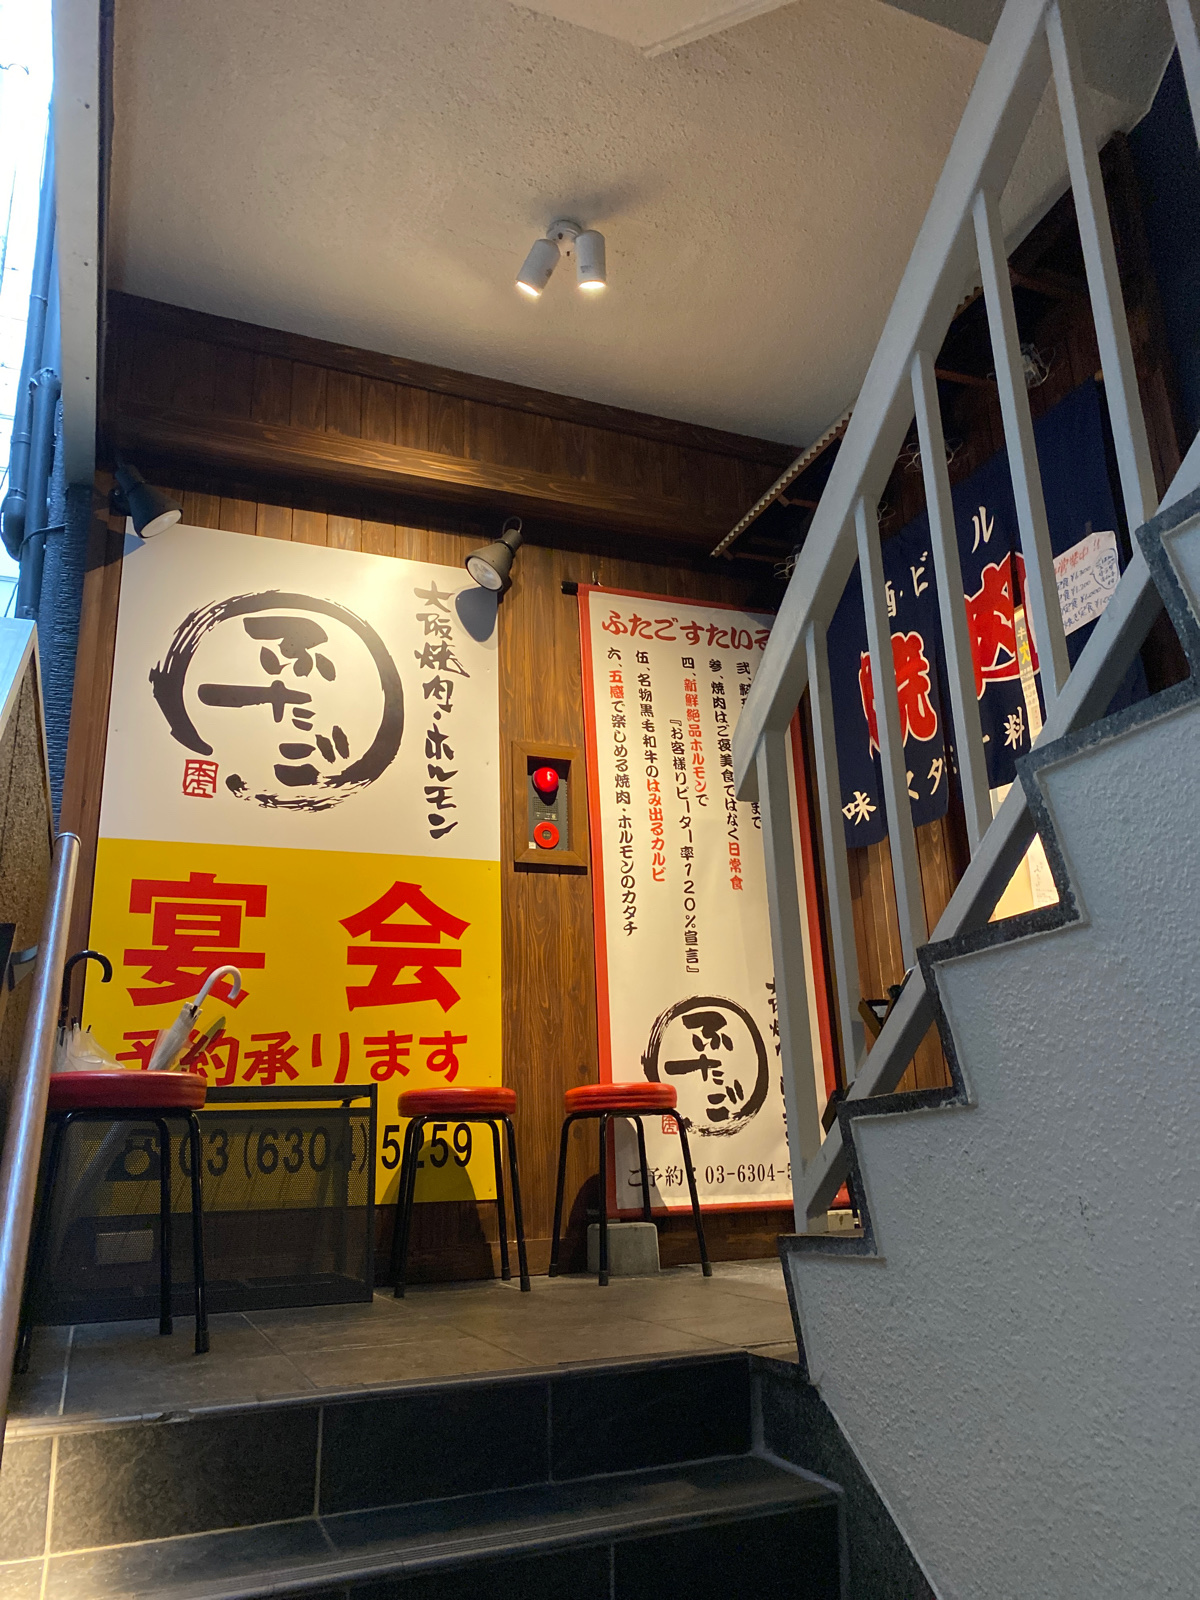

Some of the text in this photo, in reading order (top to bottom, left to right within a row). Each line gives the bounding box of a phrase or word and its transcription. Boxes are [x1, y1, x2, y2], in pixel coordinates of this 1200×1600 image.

[414, 580, 470, 840] 大阪焼肉・ホルモン
[607, 647, 638, 937] 六、五感で楽しめる焼肉・ホルモンのカタチ
[635, 650, 667, 882] 伍、名物黒毛和牛のはみ出るカルビ
